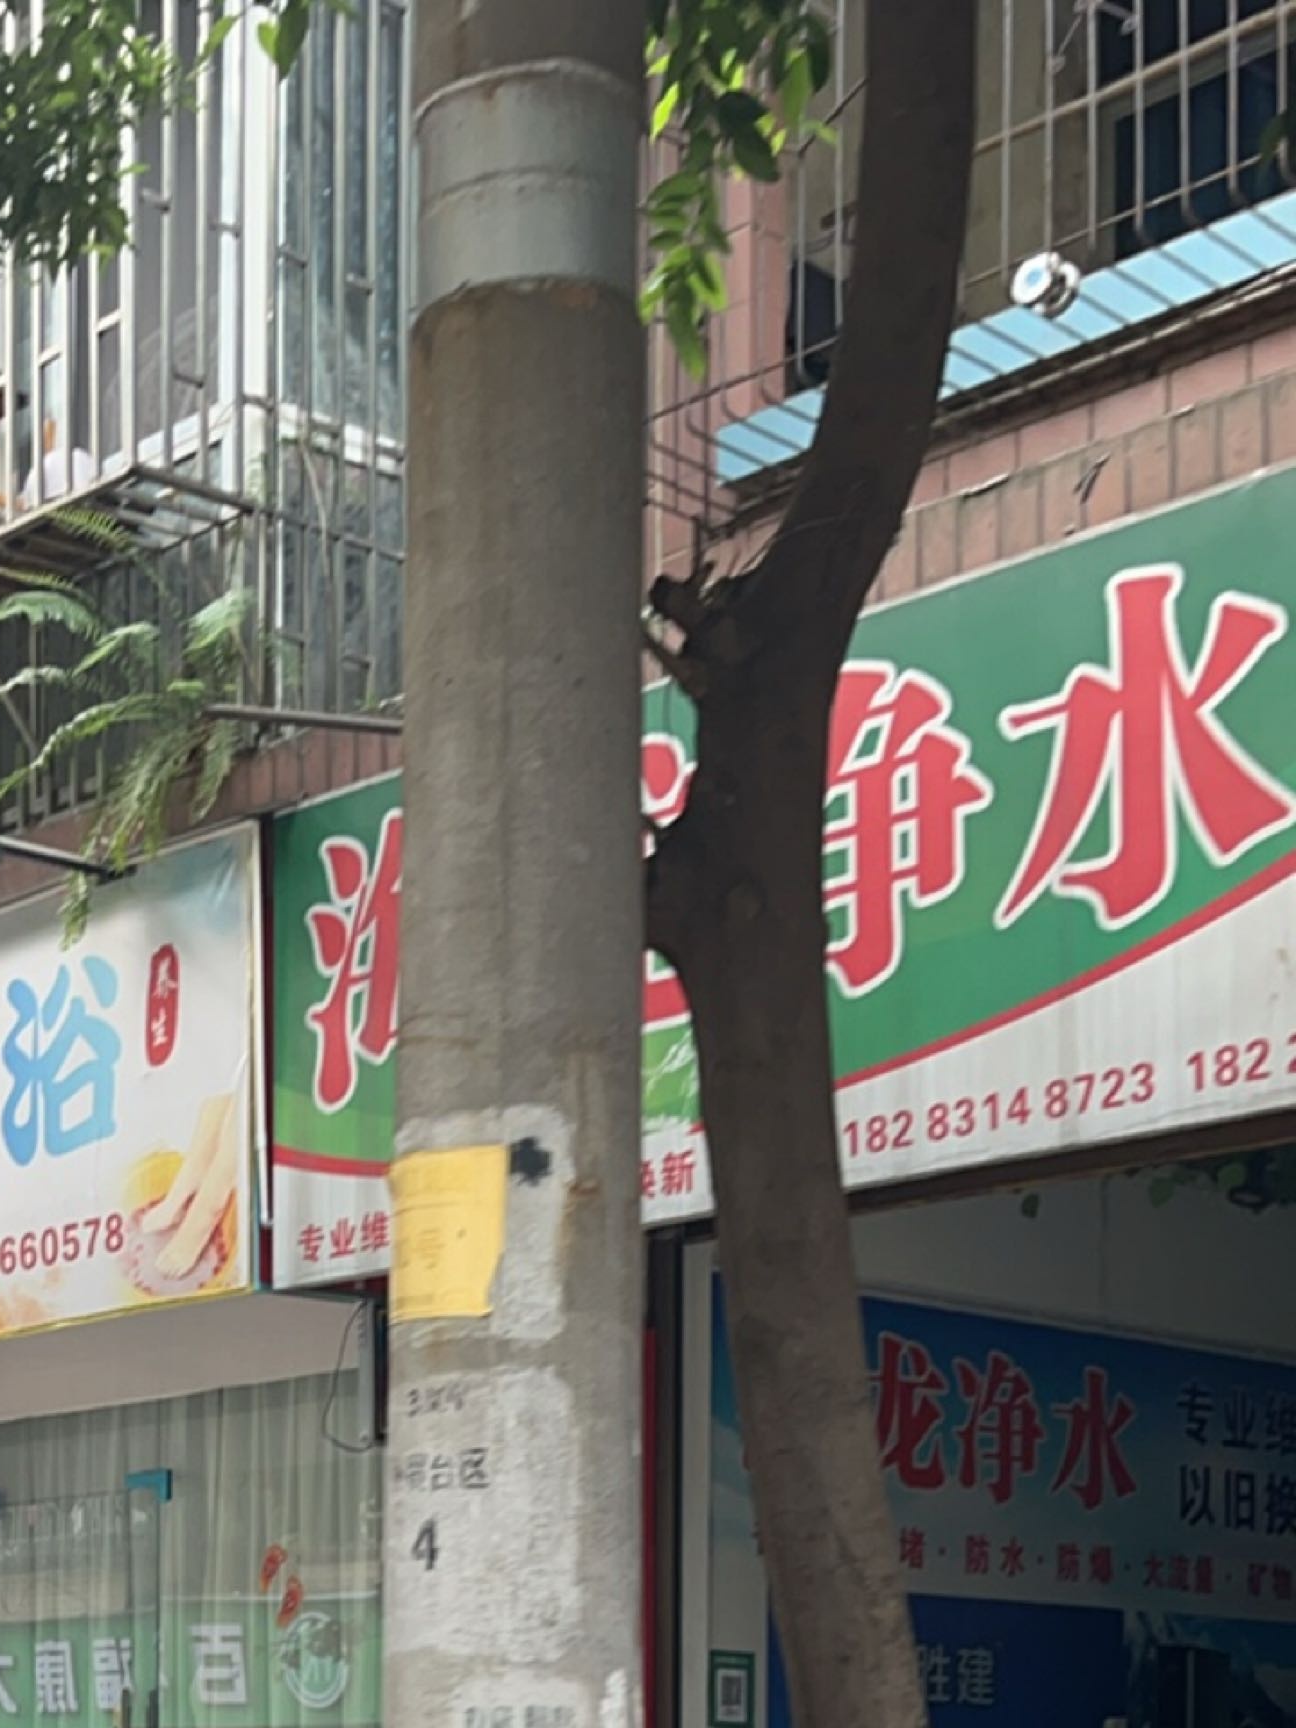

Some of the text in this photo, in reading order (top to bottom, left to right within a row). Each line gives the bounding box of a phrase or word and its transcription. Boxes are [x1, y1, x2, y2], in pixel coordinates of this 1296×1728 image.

[150, 961, 176, 1048] 养生
[843, 1110, 914, 1158] 182
[926, 1086, 1032, 1141] 8314
[1044, 1062, 1156, 1119] 8723
[1187, 1037, 1272, 1092] 182
[742, 1330, 1140, 1510] 龙净水
[411, 1515, 440, 1570] 4
